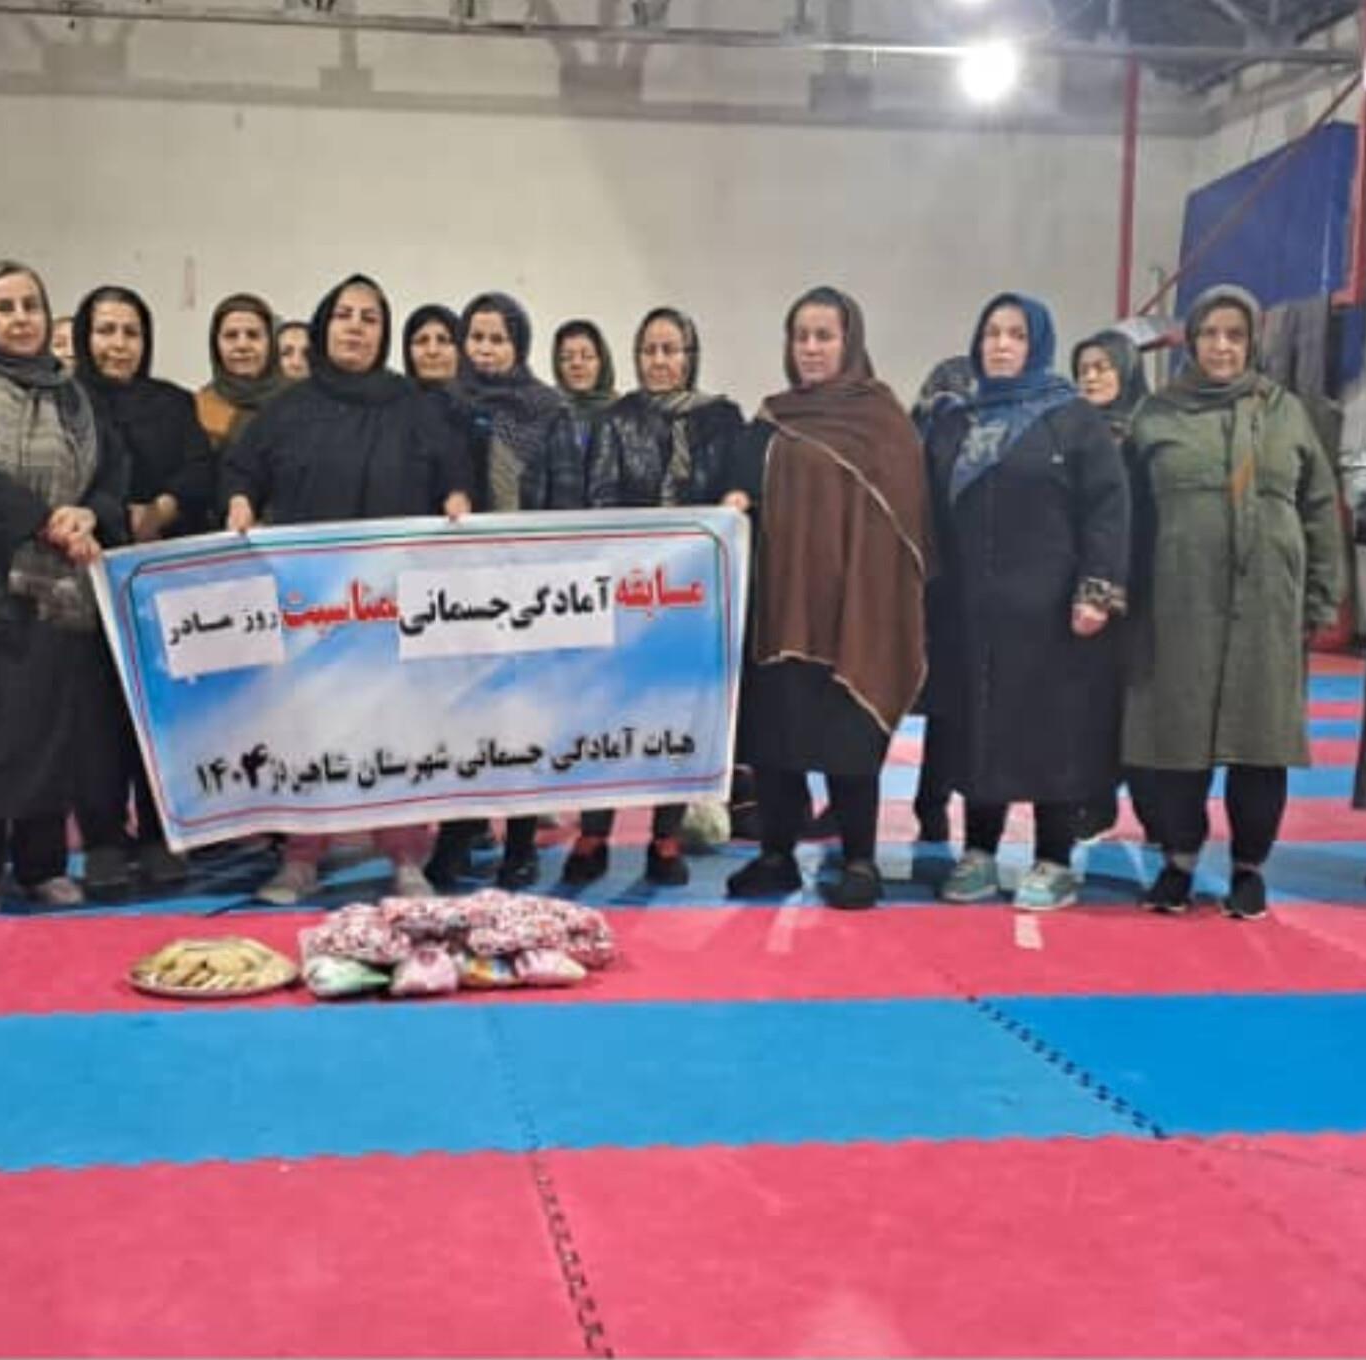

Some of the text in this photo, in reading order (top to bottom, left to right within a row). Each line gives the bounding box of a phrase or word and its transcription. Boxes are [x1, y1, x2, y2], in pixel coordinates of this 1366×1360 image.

[399, 587, 510, 636] جسمانی
[510, 575, 611, 630] آمادگی
[614, 565, 704, 620] مسابقه
[169, 610, 233, 647] مادر
[242, 607, 278, 635] روز
[358, 742, 449, 789] شهرستان
[457, 738, 543, 780] جسمانی
[551, 727, 635, 772] آمادگی
